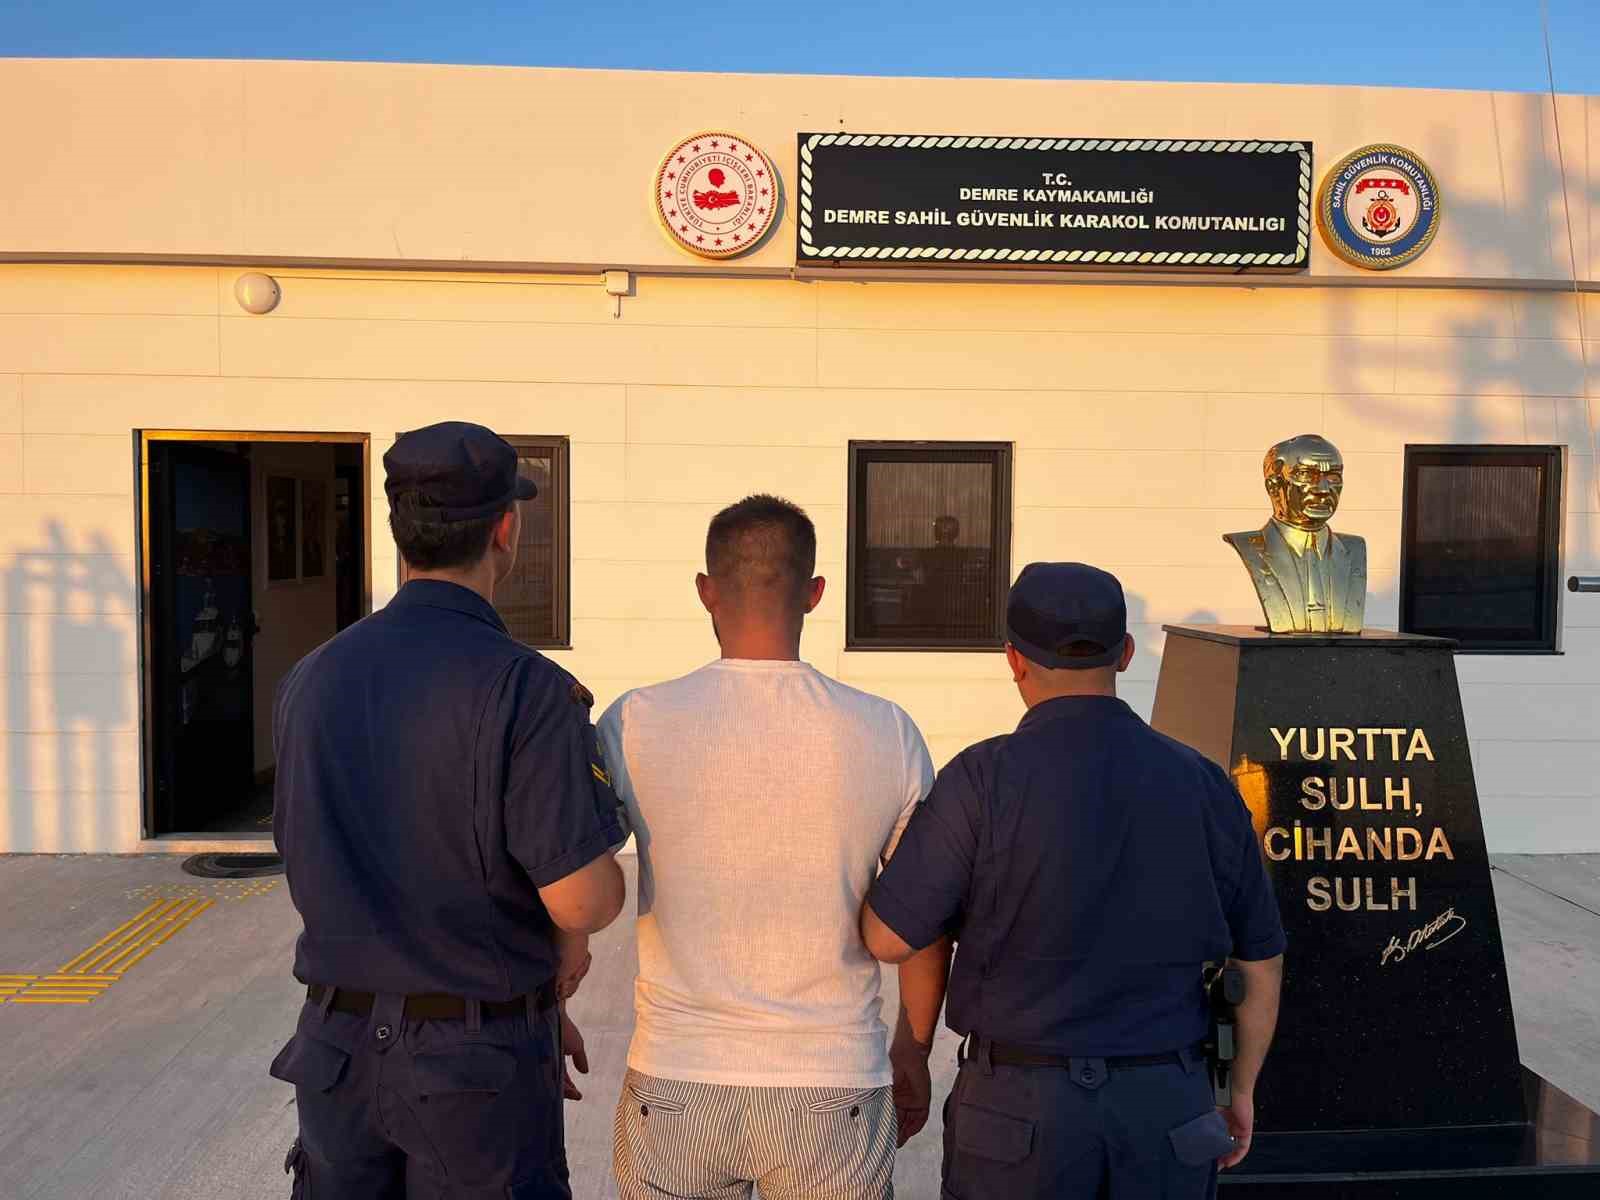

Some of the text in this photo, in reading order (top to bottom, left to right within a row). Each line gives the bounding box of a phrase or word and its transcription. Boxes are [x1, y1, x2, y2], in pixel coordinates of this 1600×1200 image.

[960, 188, 1153, 204] DEMRE KAYMAKAMLIĞI
[1042, 173, 1072, 185] T.C.
[1333, 153, 1433, 210] SAHİL GÜVENLİK KOMUTANLIĞI
[824, 208, 1285, 232] DEMRE SAHİL GÜVENLİK KARAKOL KOMUTANLIGI
[1270, 727, 1434, 760] YURTTA
[1301, 777, 1422, 816] SULH,
[1264, 820, 1454, 861] CİHANDA
[1307, 876, 1417, 911] SULH
